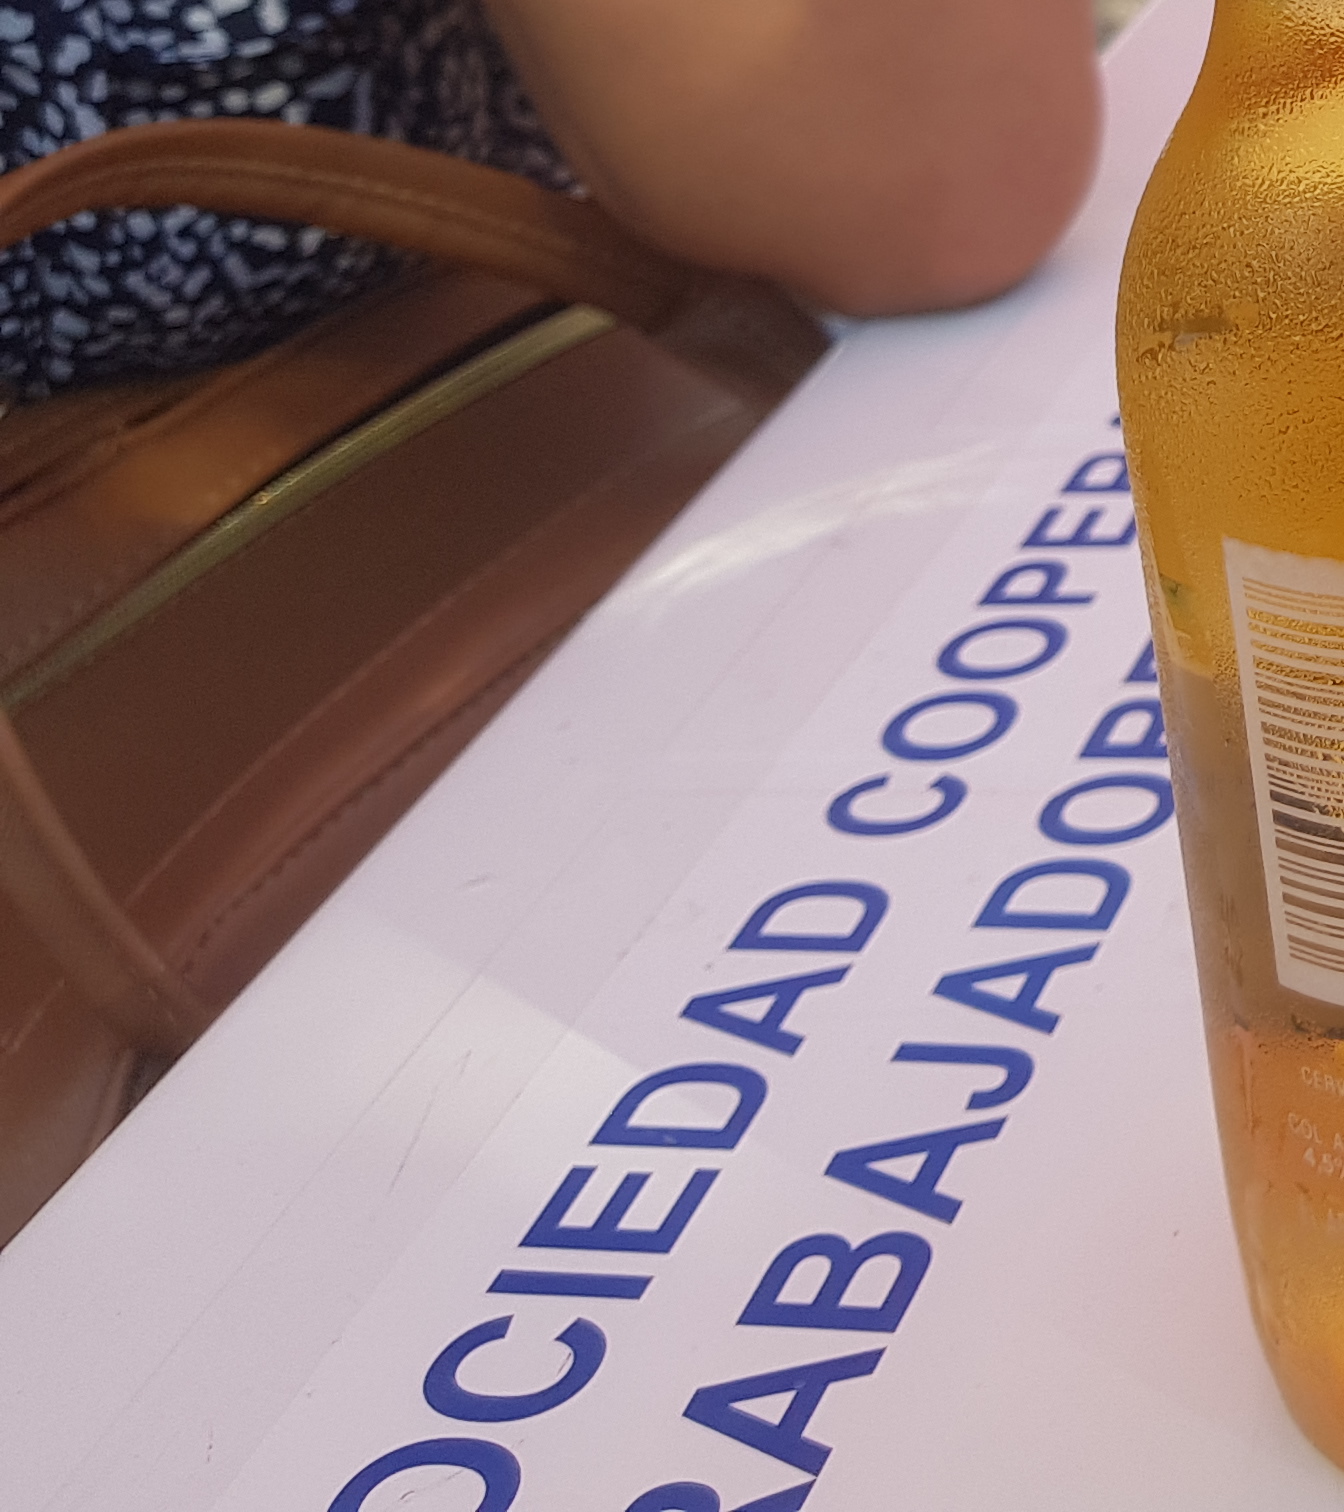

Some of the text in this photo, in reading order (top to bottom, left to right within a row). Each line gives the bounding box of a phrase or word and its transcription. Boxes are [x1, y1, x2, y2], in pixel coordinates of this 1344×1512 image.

[326, 414, 1138, 1512] OCIEDAD COOPER
[625, 638, 1176, 1512] ABAJADOR
